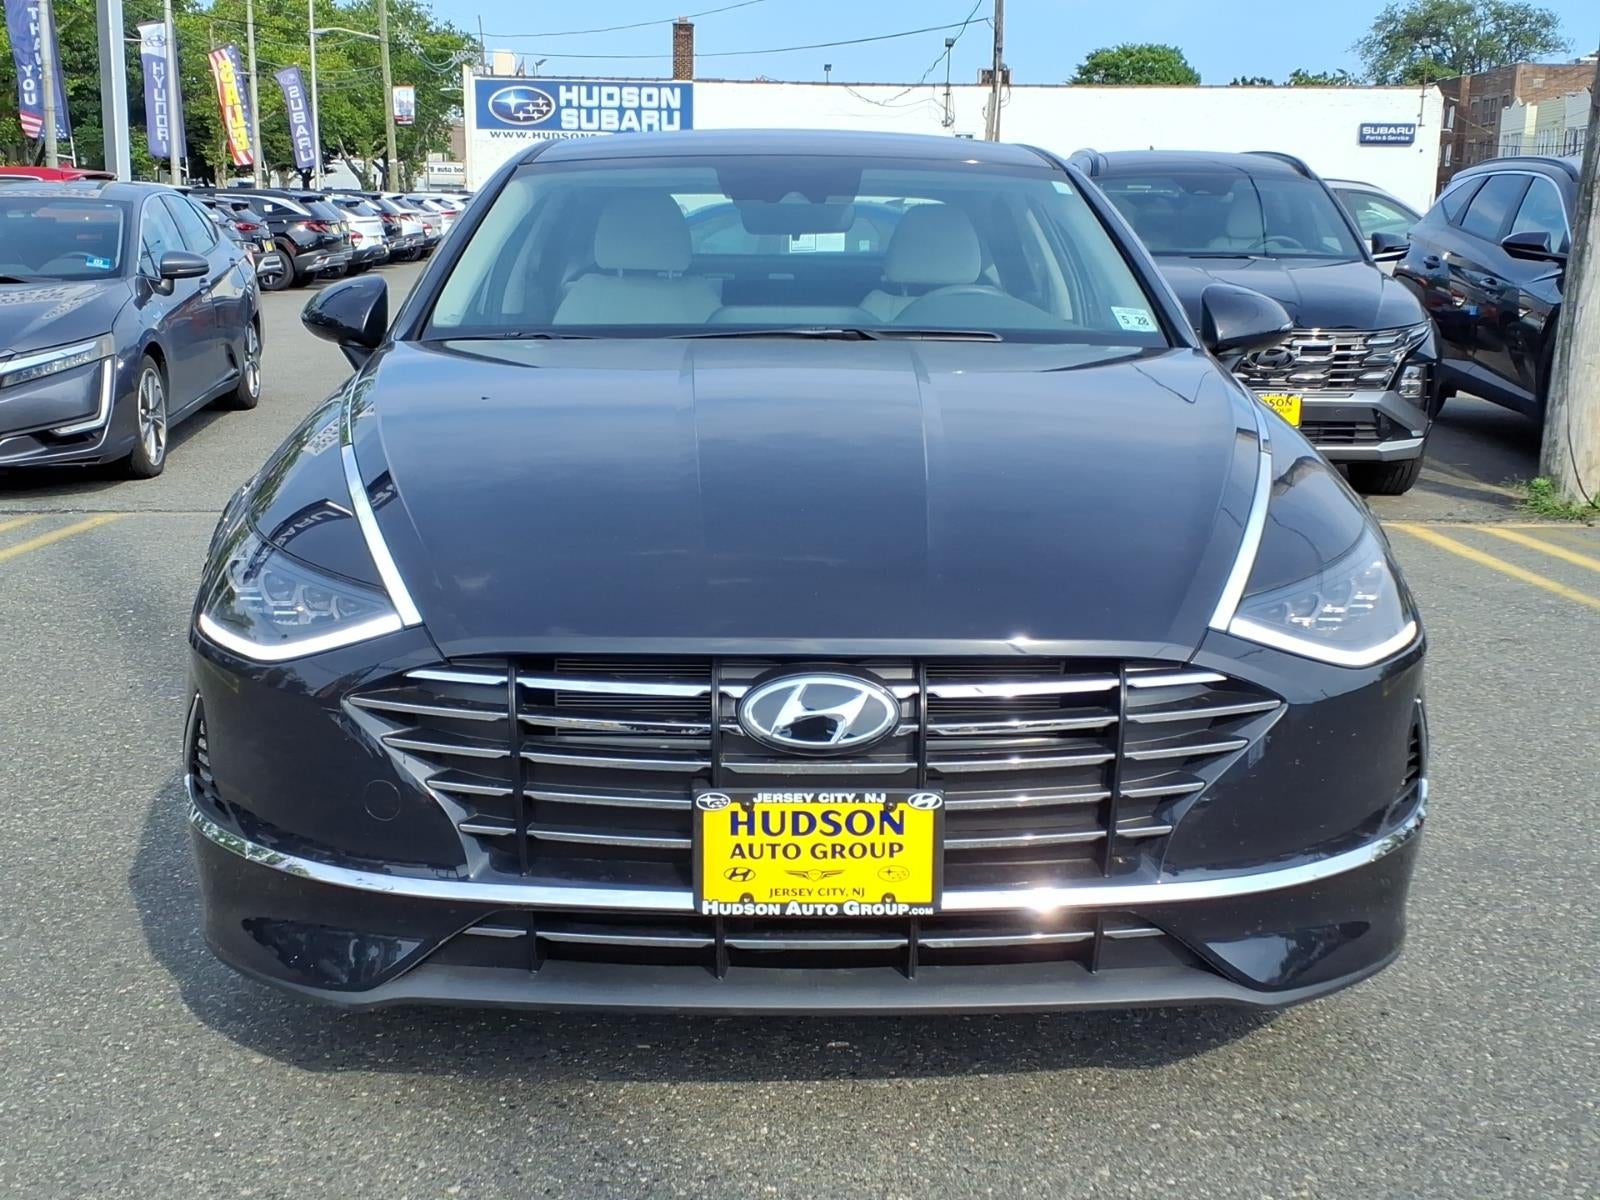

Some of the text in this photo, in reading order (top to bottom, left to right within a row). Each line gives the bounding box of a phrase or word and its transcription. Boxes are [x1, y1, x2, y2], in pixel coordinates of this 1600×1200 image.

[559, 85, 681, 109] HUDSON
[152, 62, 169, 153] HYUNDAI
[560, 108, 681, 132] SUBARU
[1362, 126, 1414, 135] SUBARU
[1121, 315, 1130, 324] 5
[752, 793, 887, 804] JERSEY CITY, NJ
[730, 809, 905, 837] HUDSON
[730, 842, 904, 860] AUTO GROUP
[769, 887, 866, 898] JERSEY CITY, NJ
[702, 900, 781, 916] HUDSON
[785, 900, 838, 916] AUTO
